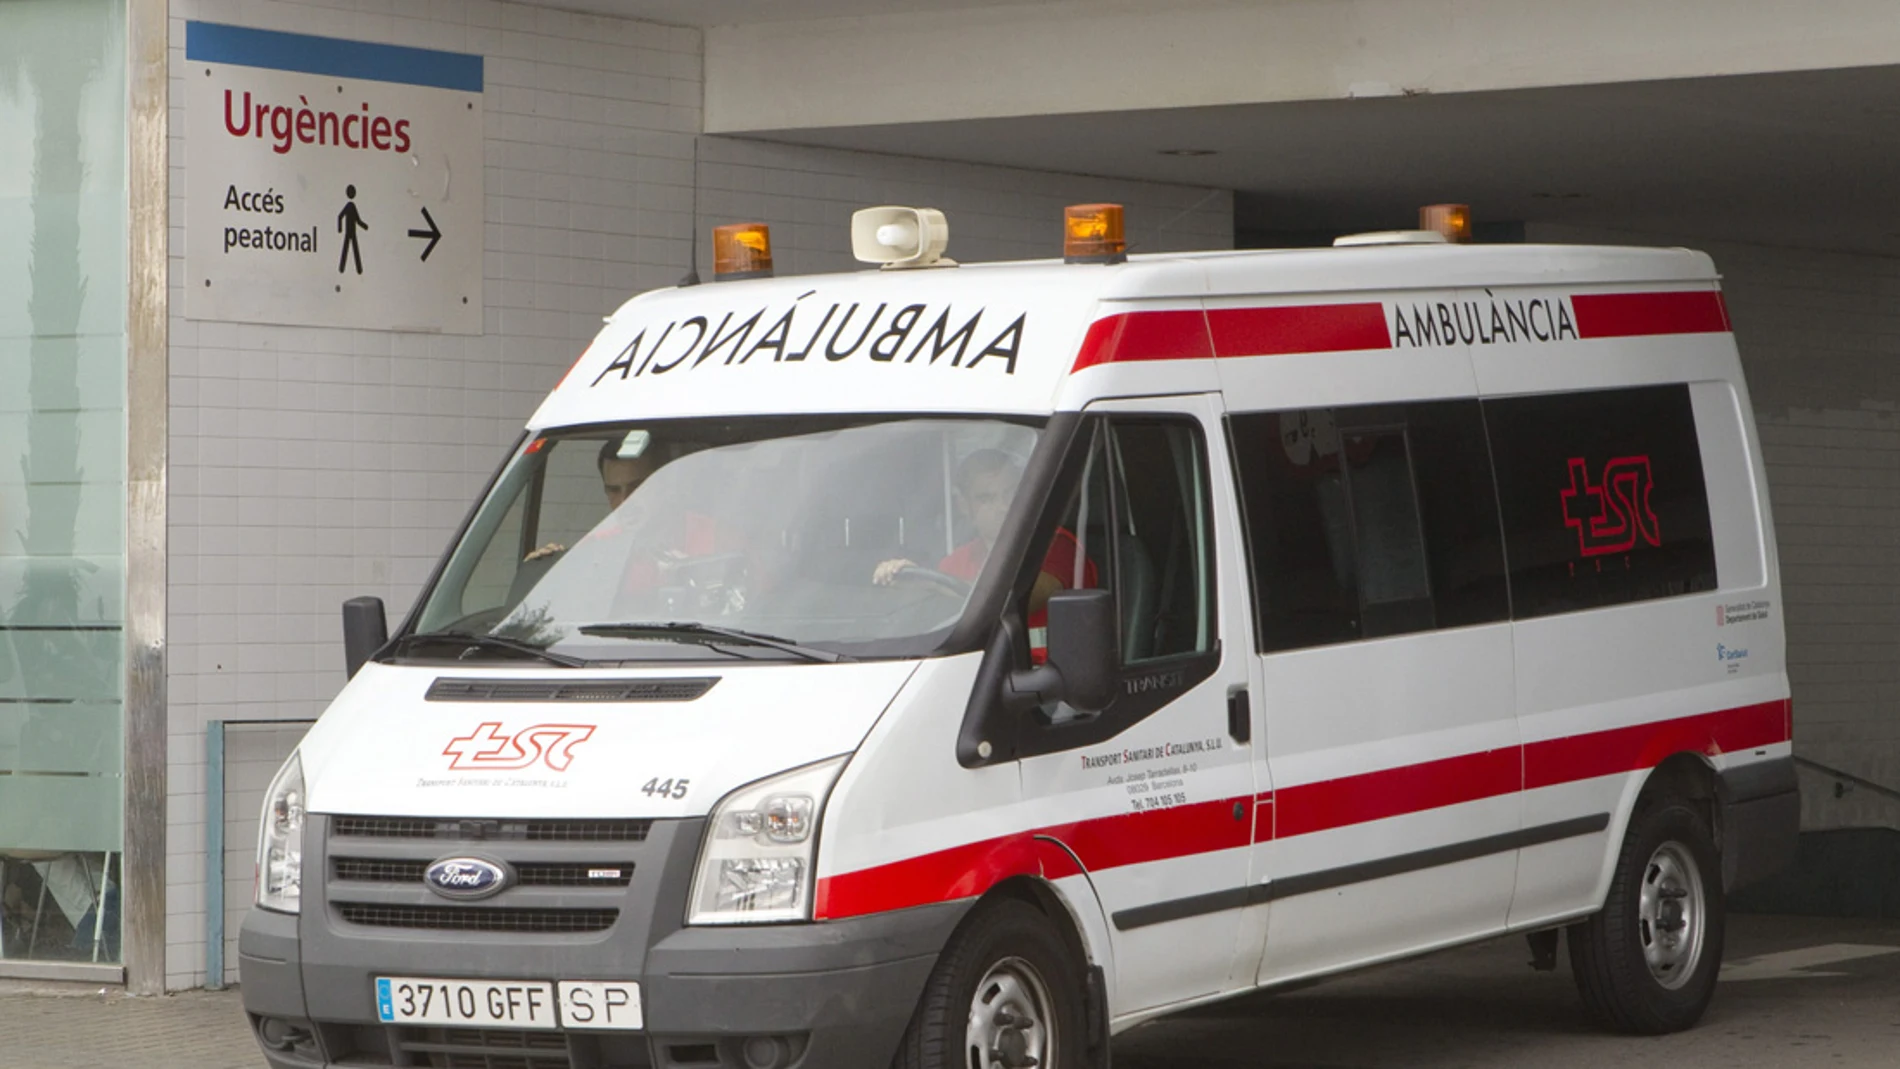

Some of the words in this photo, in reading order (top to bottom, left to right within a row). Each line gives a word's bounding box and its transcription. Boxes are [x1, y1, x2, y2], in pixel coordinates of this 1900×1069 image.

[224, 89, 411, 154] Urgències
[224, 185, 285, 214] Accés
[223, 226, 318, 253] peatonal
[1395, 288, 1577, 348] AMBULÀNCIA
[641, 776, 690, 800] 445
[439, 864, 481, 887] Ford
[382, 1003, 391, 1015] E
[398, 983, 477, 1019] 3710
[486, 986, 545, 1022] GFF
